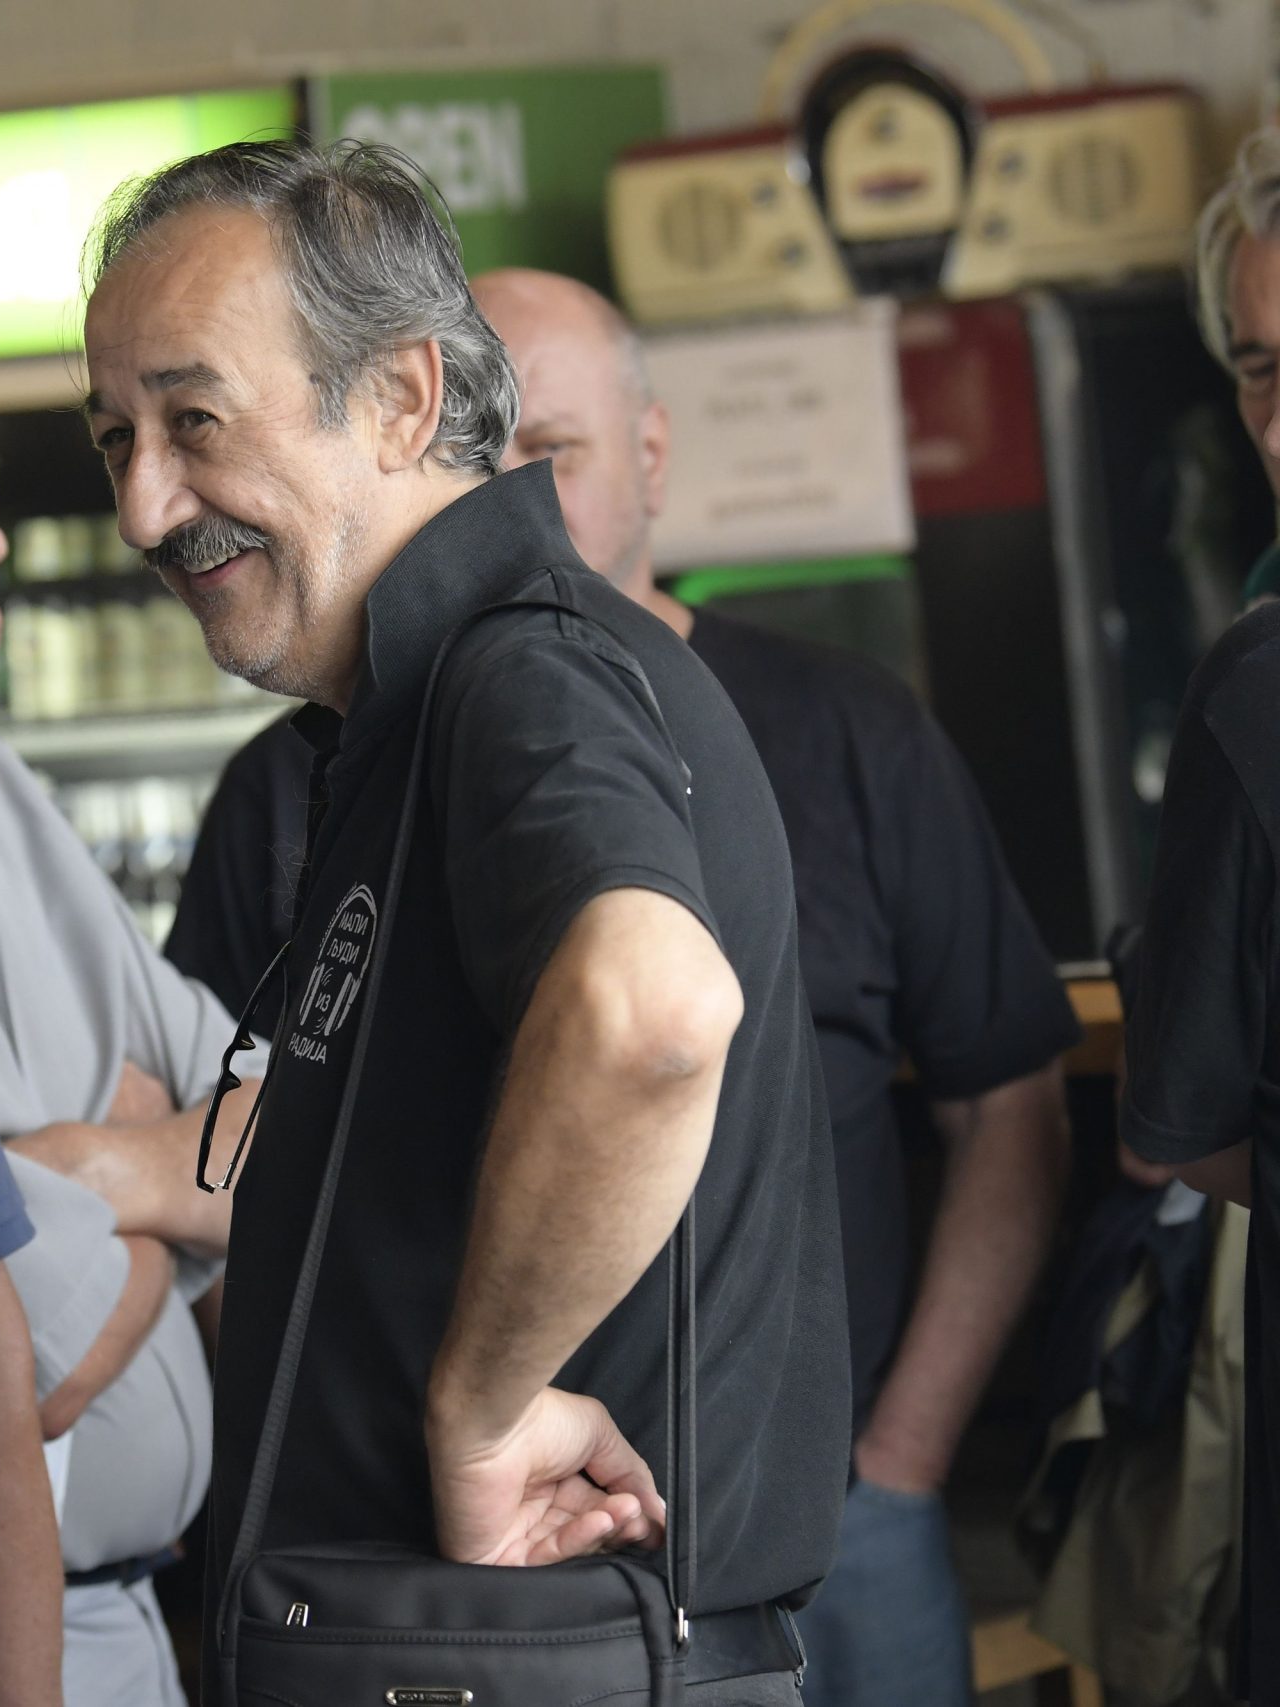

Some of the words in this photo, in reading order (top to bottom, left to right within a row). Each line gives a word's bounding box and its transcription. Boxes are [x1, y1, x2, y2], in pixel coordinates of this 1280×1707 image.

[338, 911, 369, 936] МАЛИ
[327, 938, 360, 964] ЉУДИ
[315, 992, 331, 1012] ИЗ
[288, 1032, 328, 1064] РАДИЈА
